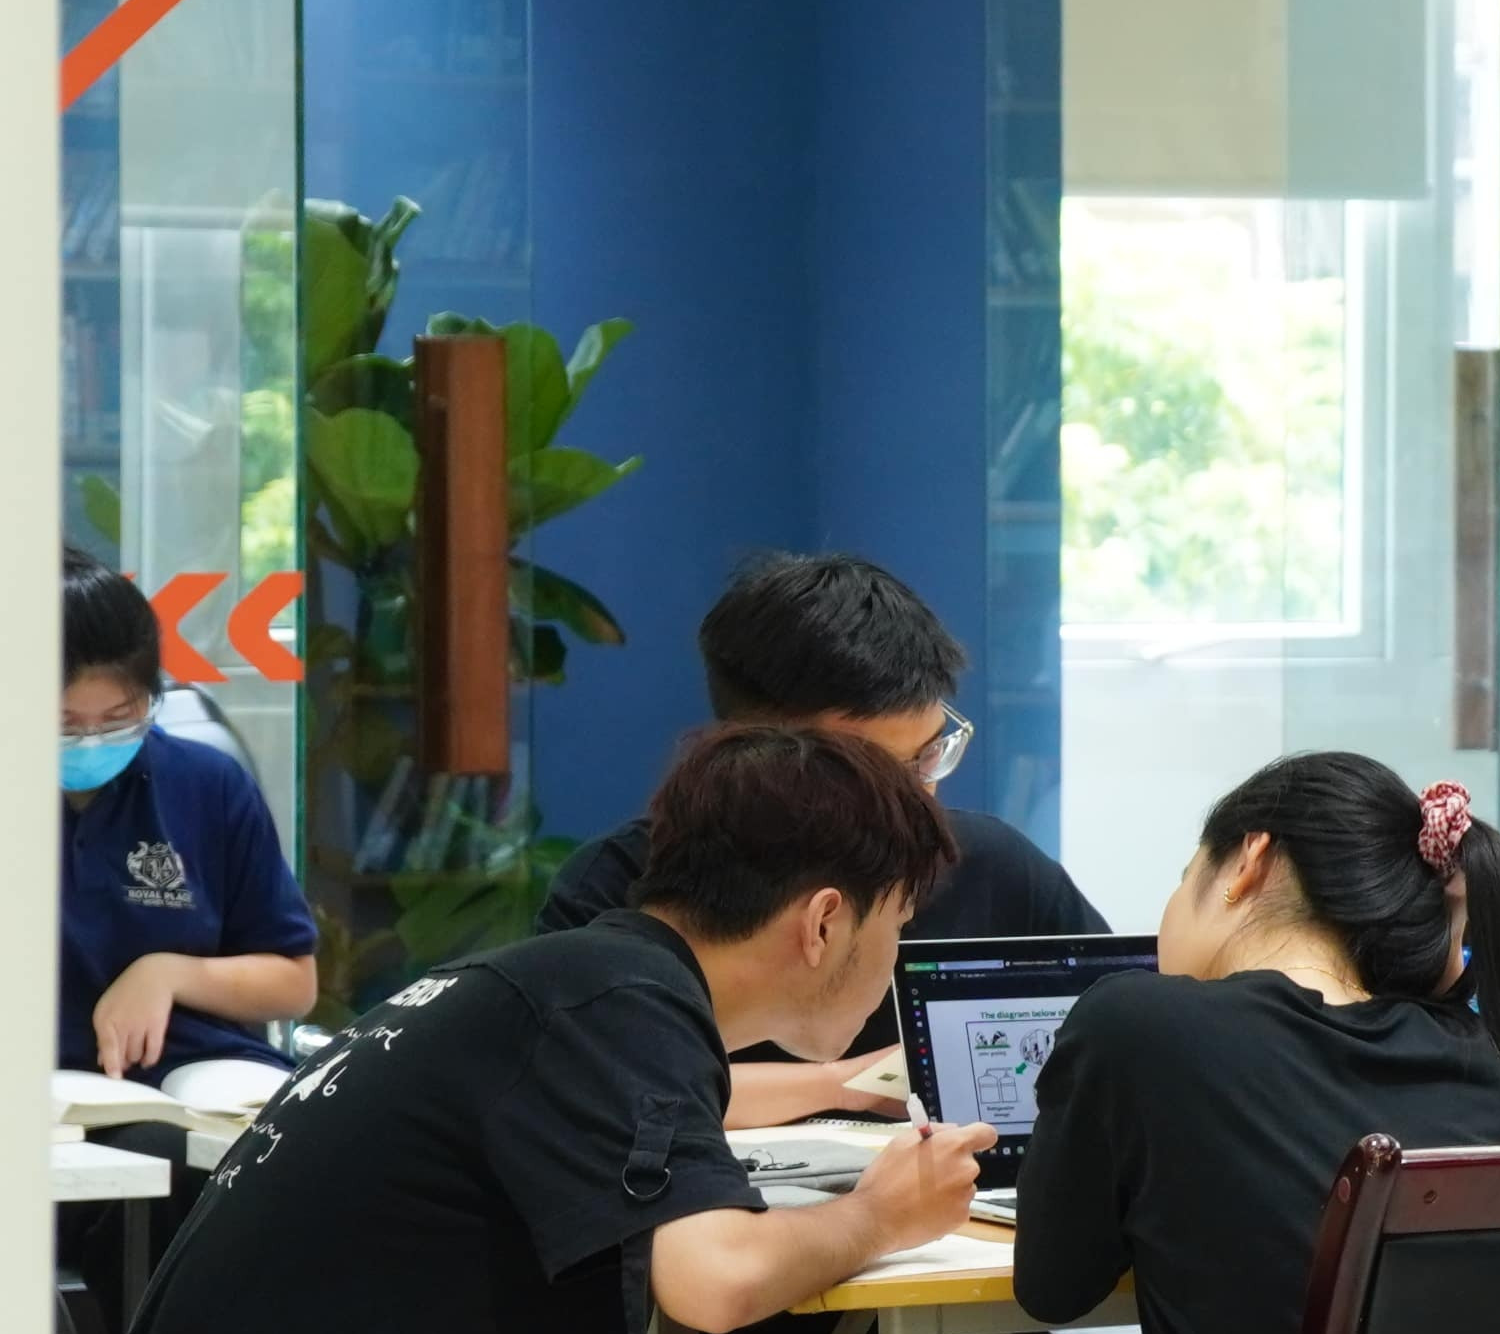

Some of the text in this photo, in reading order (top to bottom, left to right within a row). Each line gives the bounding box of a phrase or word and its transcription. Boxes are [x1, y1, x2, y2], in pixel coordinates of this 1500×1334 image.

[981, 1012, 996, 1020] The
[997, 1011, 1030, 1020] diagram
[1032, 1008, 1056, 1018] below
